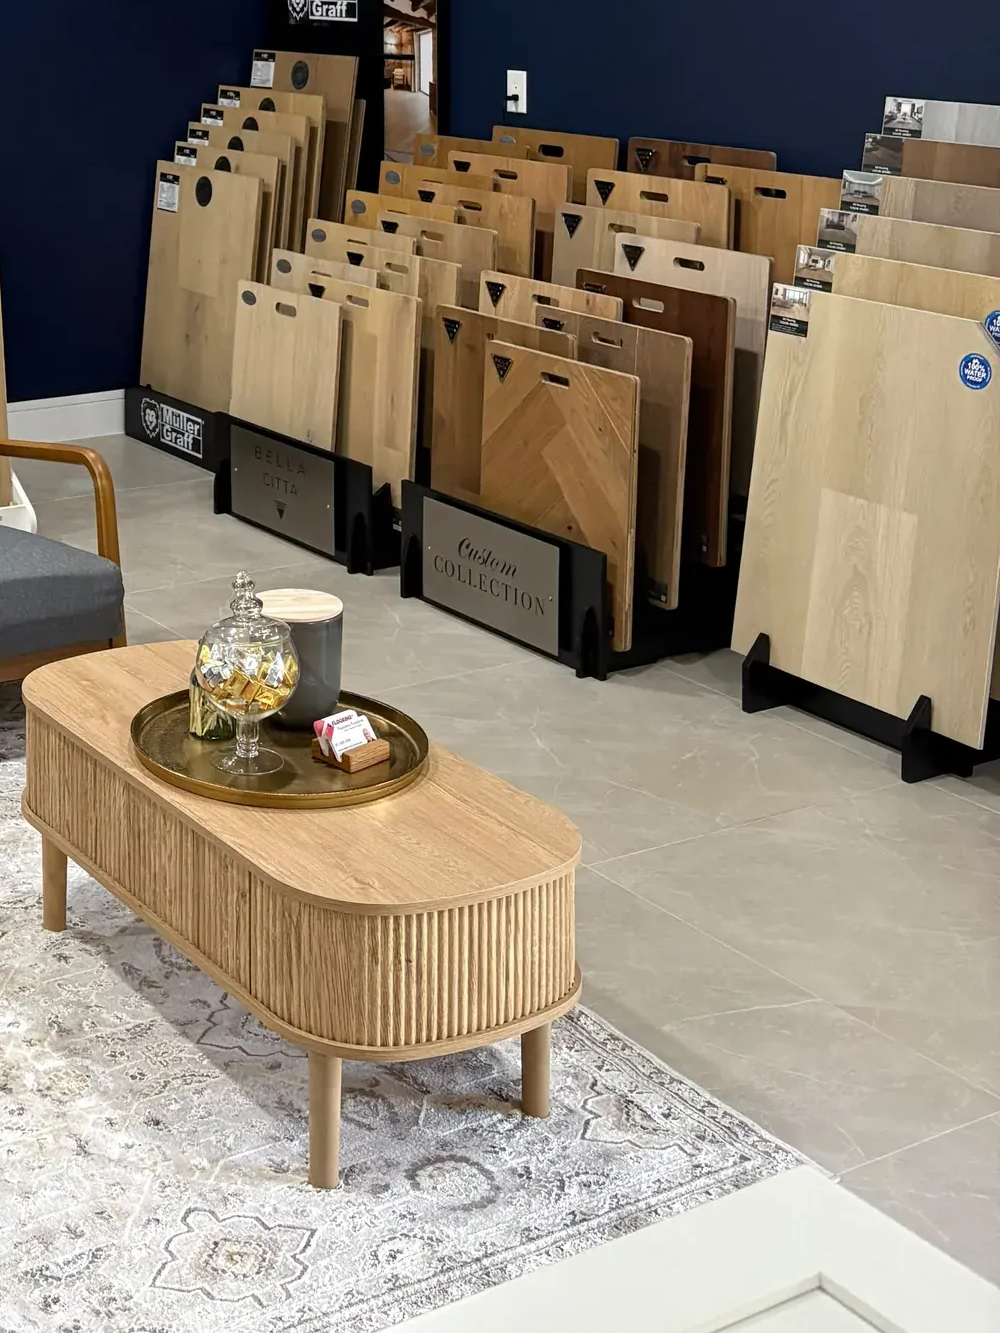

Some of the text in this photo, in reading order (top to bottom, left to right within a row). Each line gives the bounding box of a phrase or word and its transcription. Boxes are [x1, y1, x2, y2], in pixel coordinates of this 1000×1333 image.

[312, 1, 346, 17] Graff
[964, 368, 987, 379] WATER
[968, 362, 985, 372] 100%
[162, 408, 200, 435] Müller
[163, 425, 193, 450] Graff
[255, 445, 306, 475] BELLA
[263, 472, 298, 495] CITTA
[457, 537, 518, 578] Custom
[434, 555, 545, 616] COLLECTION
